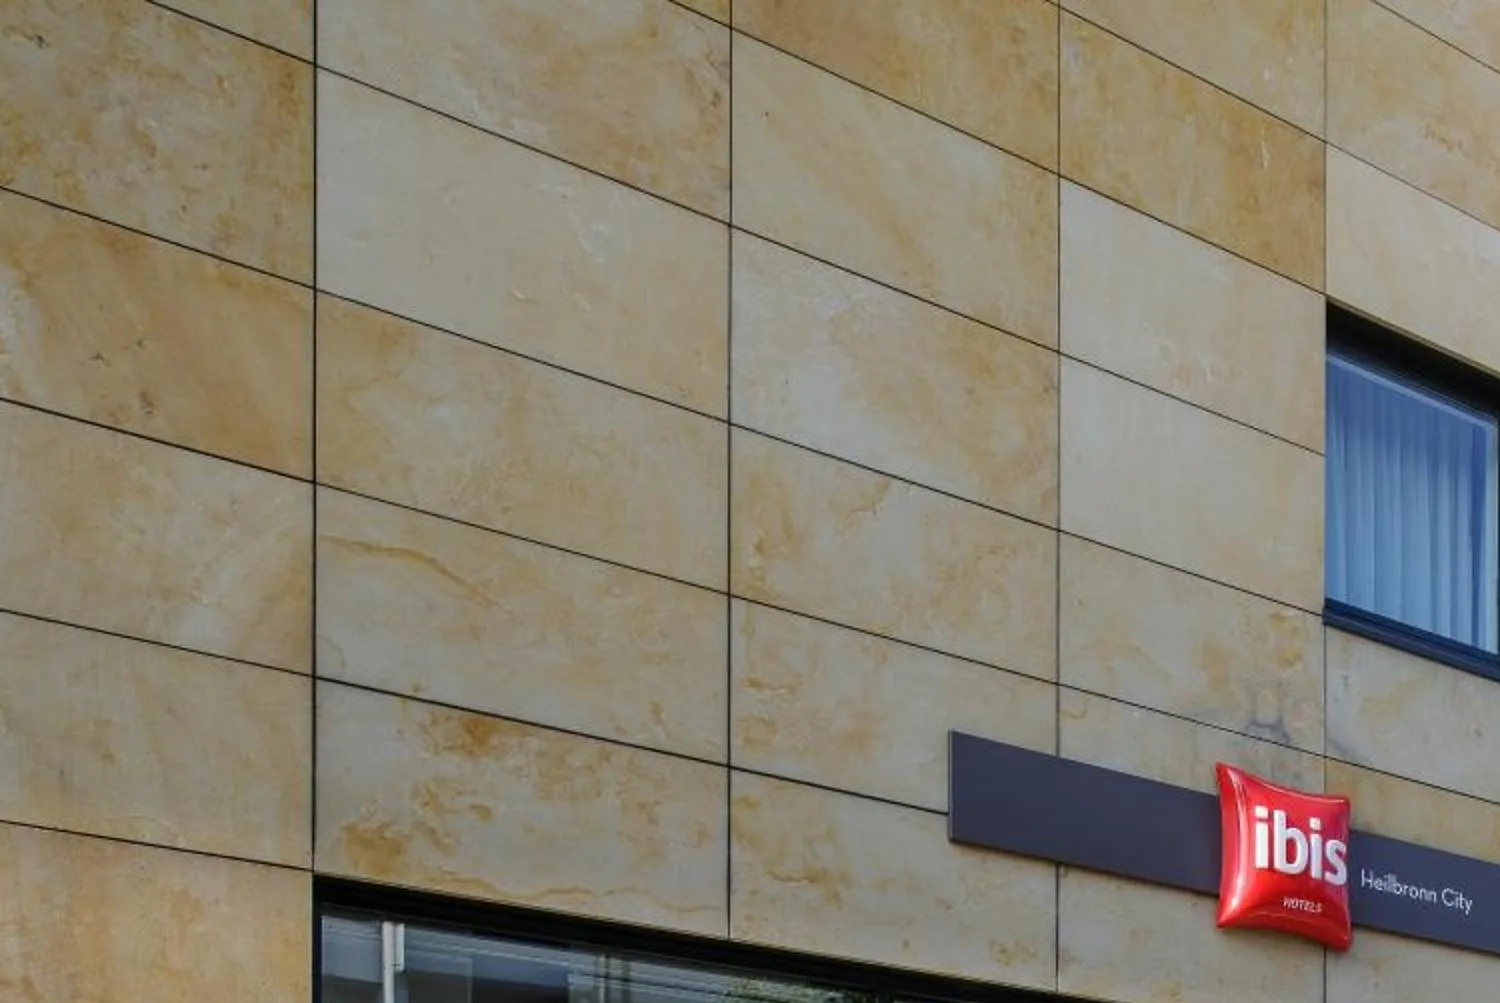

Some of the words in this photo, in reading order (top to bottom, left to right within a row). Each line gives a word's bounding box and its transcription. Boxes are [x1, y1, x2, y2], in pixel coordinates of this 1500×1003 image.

[1254, 804, 1347, 885] ibis
[1283, 897, 1322, 912] HOTELS
[1361, 868, 1437, 904] Heilbronn
[1441, 887, 1473, 915] City
